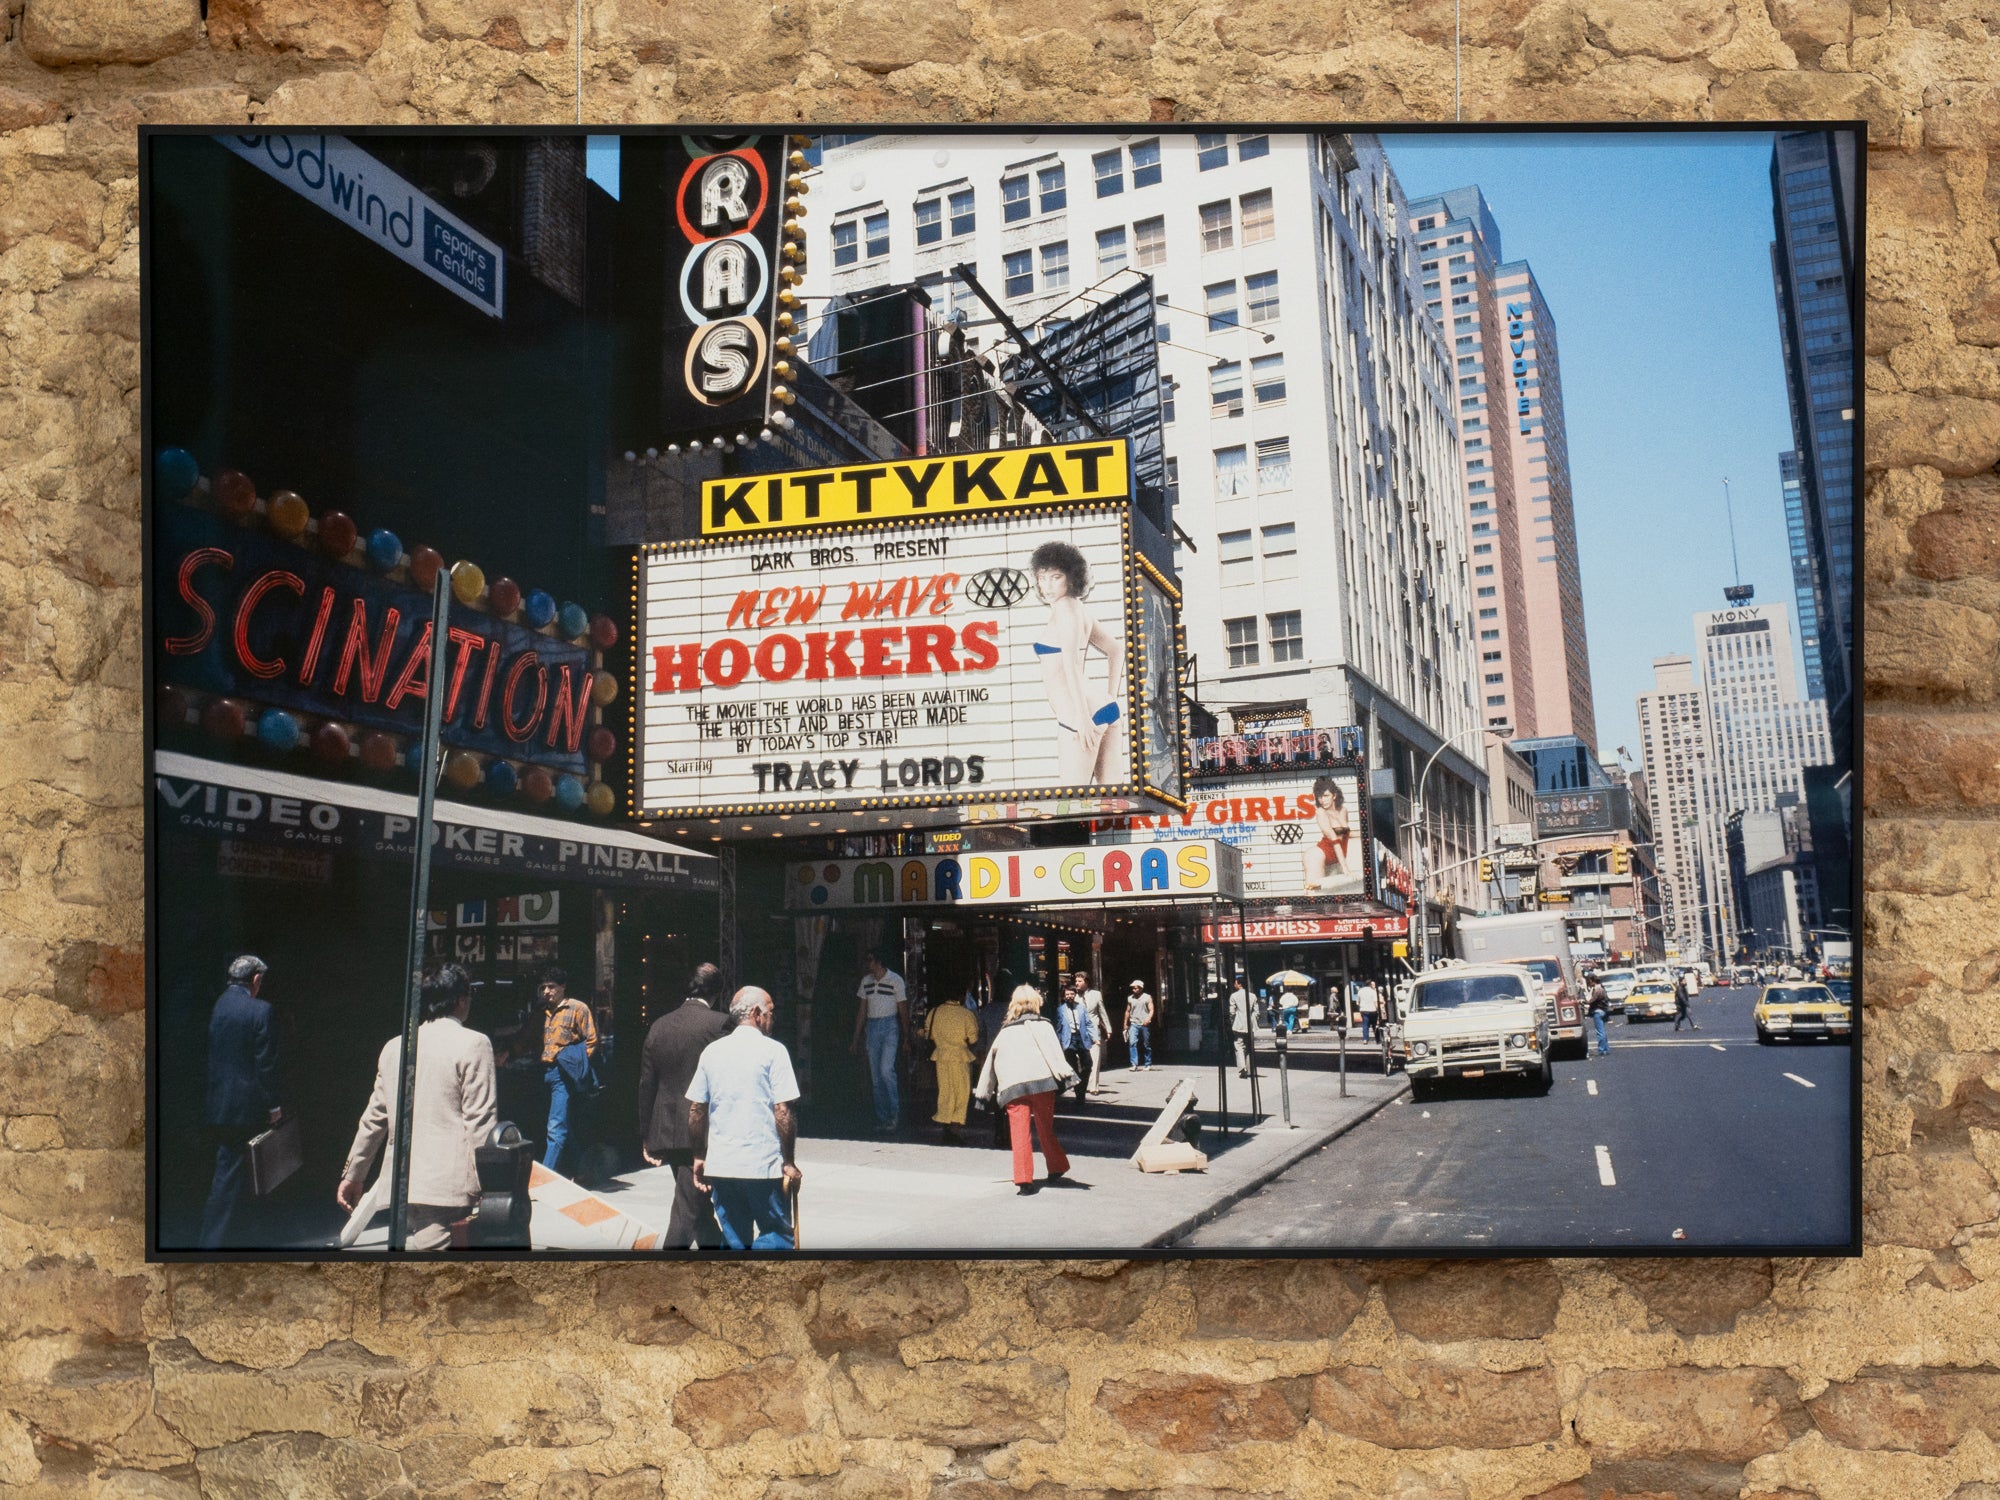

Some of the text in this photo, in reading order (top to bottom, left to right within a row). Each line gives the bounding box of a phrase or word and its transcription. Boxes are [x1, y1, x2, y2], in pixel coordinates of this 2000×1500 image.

[239, 136, 414, 249] odwind
[434, 223, 487, 270] repairs
[700, 136, 750, 393] RAS
[434, 247, 486, 293] rentals
[1506, 301, 1531, 433] NOVOTEL
[710, 446, 1115, 528] KITTYKAT
[750, 537, 950, 572] DARK BROS. PRESENT
[726, 572, 960, 630] NEW WAVE
[968, 568, 1027, 607] XXX
[1712, 608, 1760, 624] MONY
[165, 548, 593, 752] SCINATION
[652, 620, 1000, 694] HOOKERS
[686, 688, 989, 722] THE MOVIE THE WORLD HAS BEEN AWAITING
[697, 706, 968, 739] THE HOTTEST AND BEST EVER MADE
[736, 730, 899, 754] BY TODAY'S TOP STAR!
[667, 759, 712, 774] Starring
[752, 754, 986, 795] TRACY LORDS
[155, 778, 341, 831] VIDEO
[558, 841, 690, 875] PINBALL
[1205, 793, 1317, 825] GIRLS
[932, 833, 962, 843] VIDEO
[937, 843, 959, 853] XXX
[1177, 827, 1201, 837] Never
[1239, 822, 1257, 833] Box
[180, 814, 719, 887] GAMES GAMES GAME GAMES GAMES GAMES GAMES GAME
[853, 855, 1020, 903] MARDI
[1059, 845, 1211, 895] GRAS
[1245, 881, 1266, 890] NICOLE
[1244, 916, 1321, 936] EXPRESS
[1333, 924, 1354, 932] FAST
